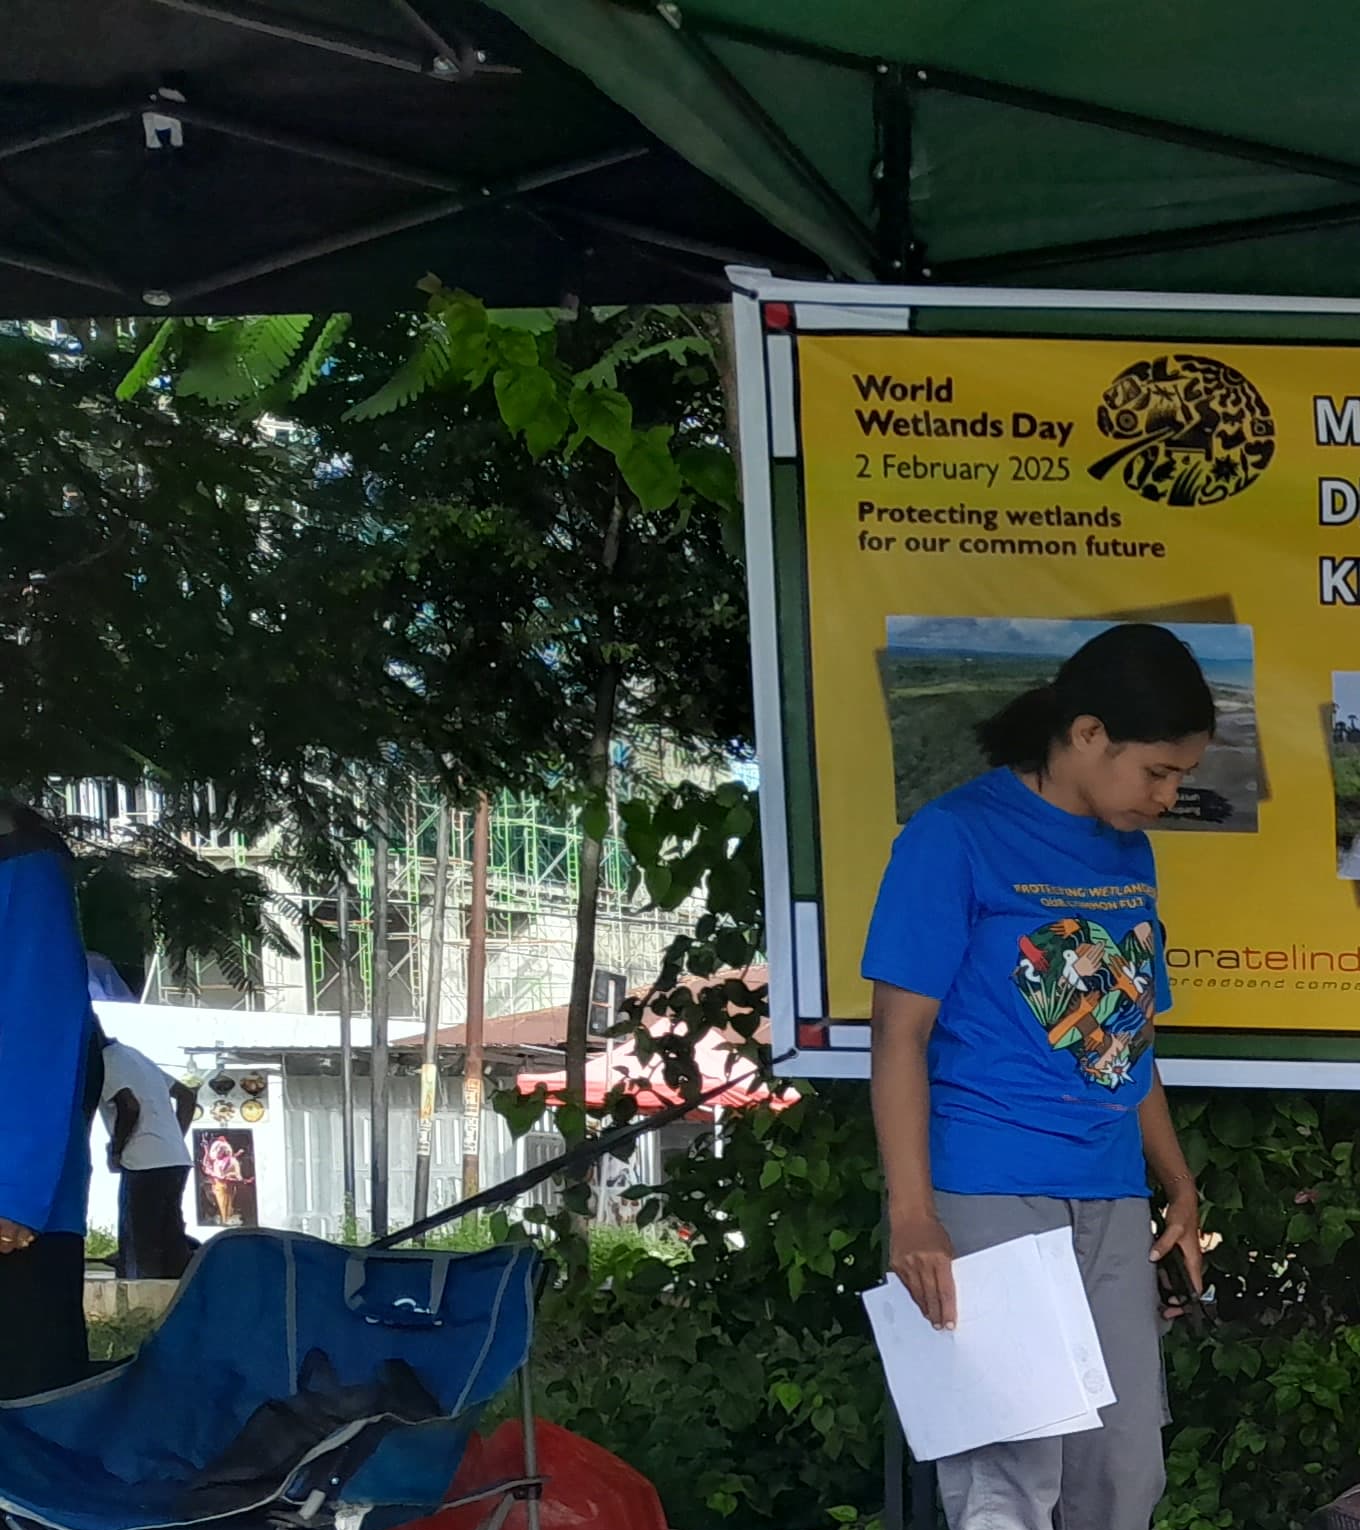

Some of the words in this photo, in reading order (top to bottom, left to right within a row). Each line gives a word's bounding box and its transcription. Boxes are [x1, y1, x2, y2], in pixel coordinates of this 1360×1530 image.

[853, 374, 953, 403] World
[855, 408, 1004, 439] Wetlands
[1012, 411, 1074, 447] Day
[855, 453, 871, 480] 2
[883, 454, 998, 488] February
[1009, 456, 1071, 482] 2025
[858, 501, 998, 532] Protecting
[1005, 504, 1122, 529] wetlands
[858, 530, 897, 553] for
[904, 534, 951, 555] our
[959, 536, 1078, 558] common
[1085, 534, 1166, 559] future
